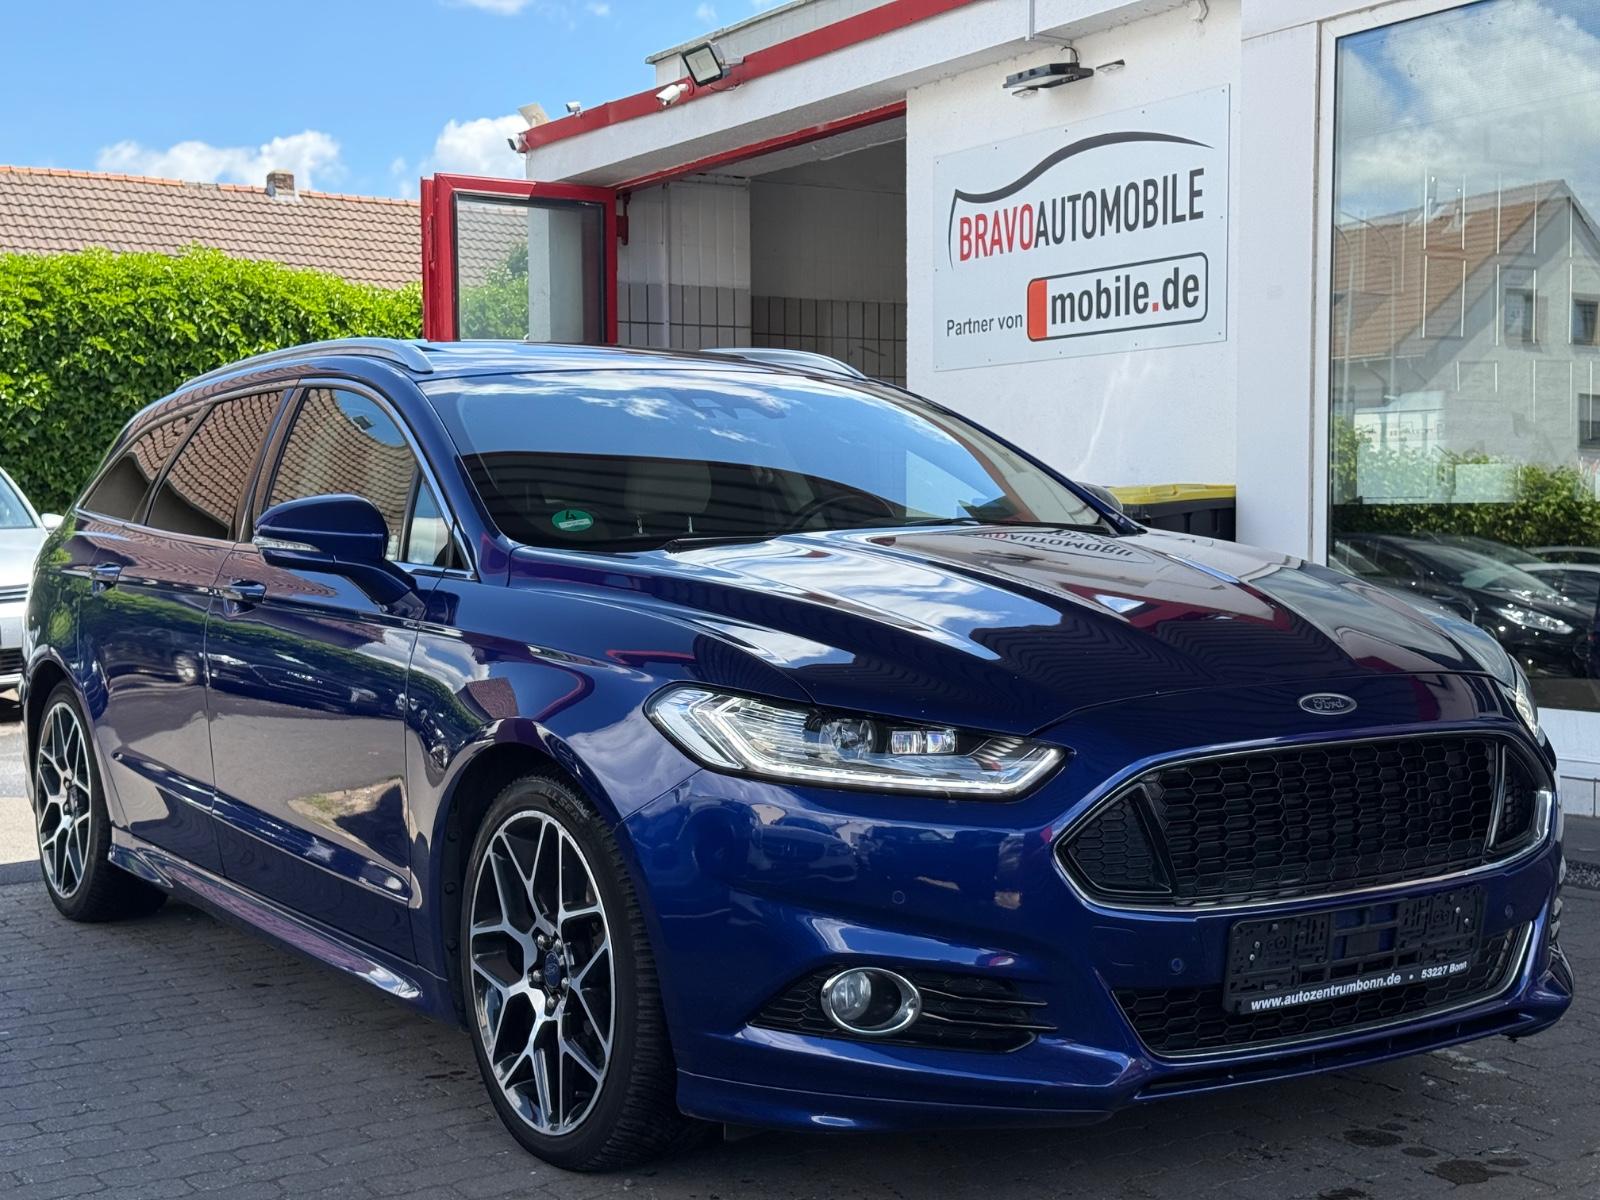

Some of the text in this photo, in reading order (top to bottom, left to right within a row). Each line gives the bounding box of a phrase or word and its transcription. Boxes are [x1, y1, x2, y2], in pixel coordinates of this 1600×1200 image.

[959, 167, 1205, 262] BRAVOAUTOMOBILE
[1051, 266, 1200, 326] mobile.de
[946, 313, 1023, 337] Partner von
[1251, 960, 1467, 1011] www.autozentrumbonn.de 53227 Bonn
